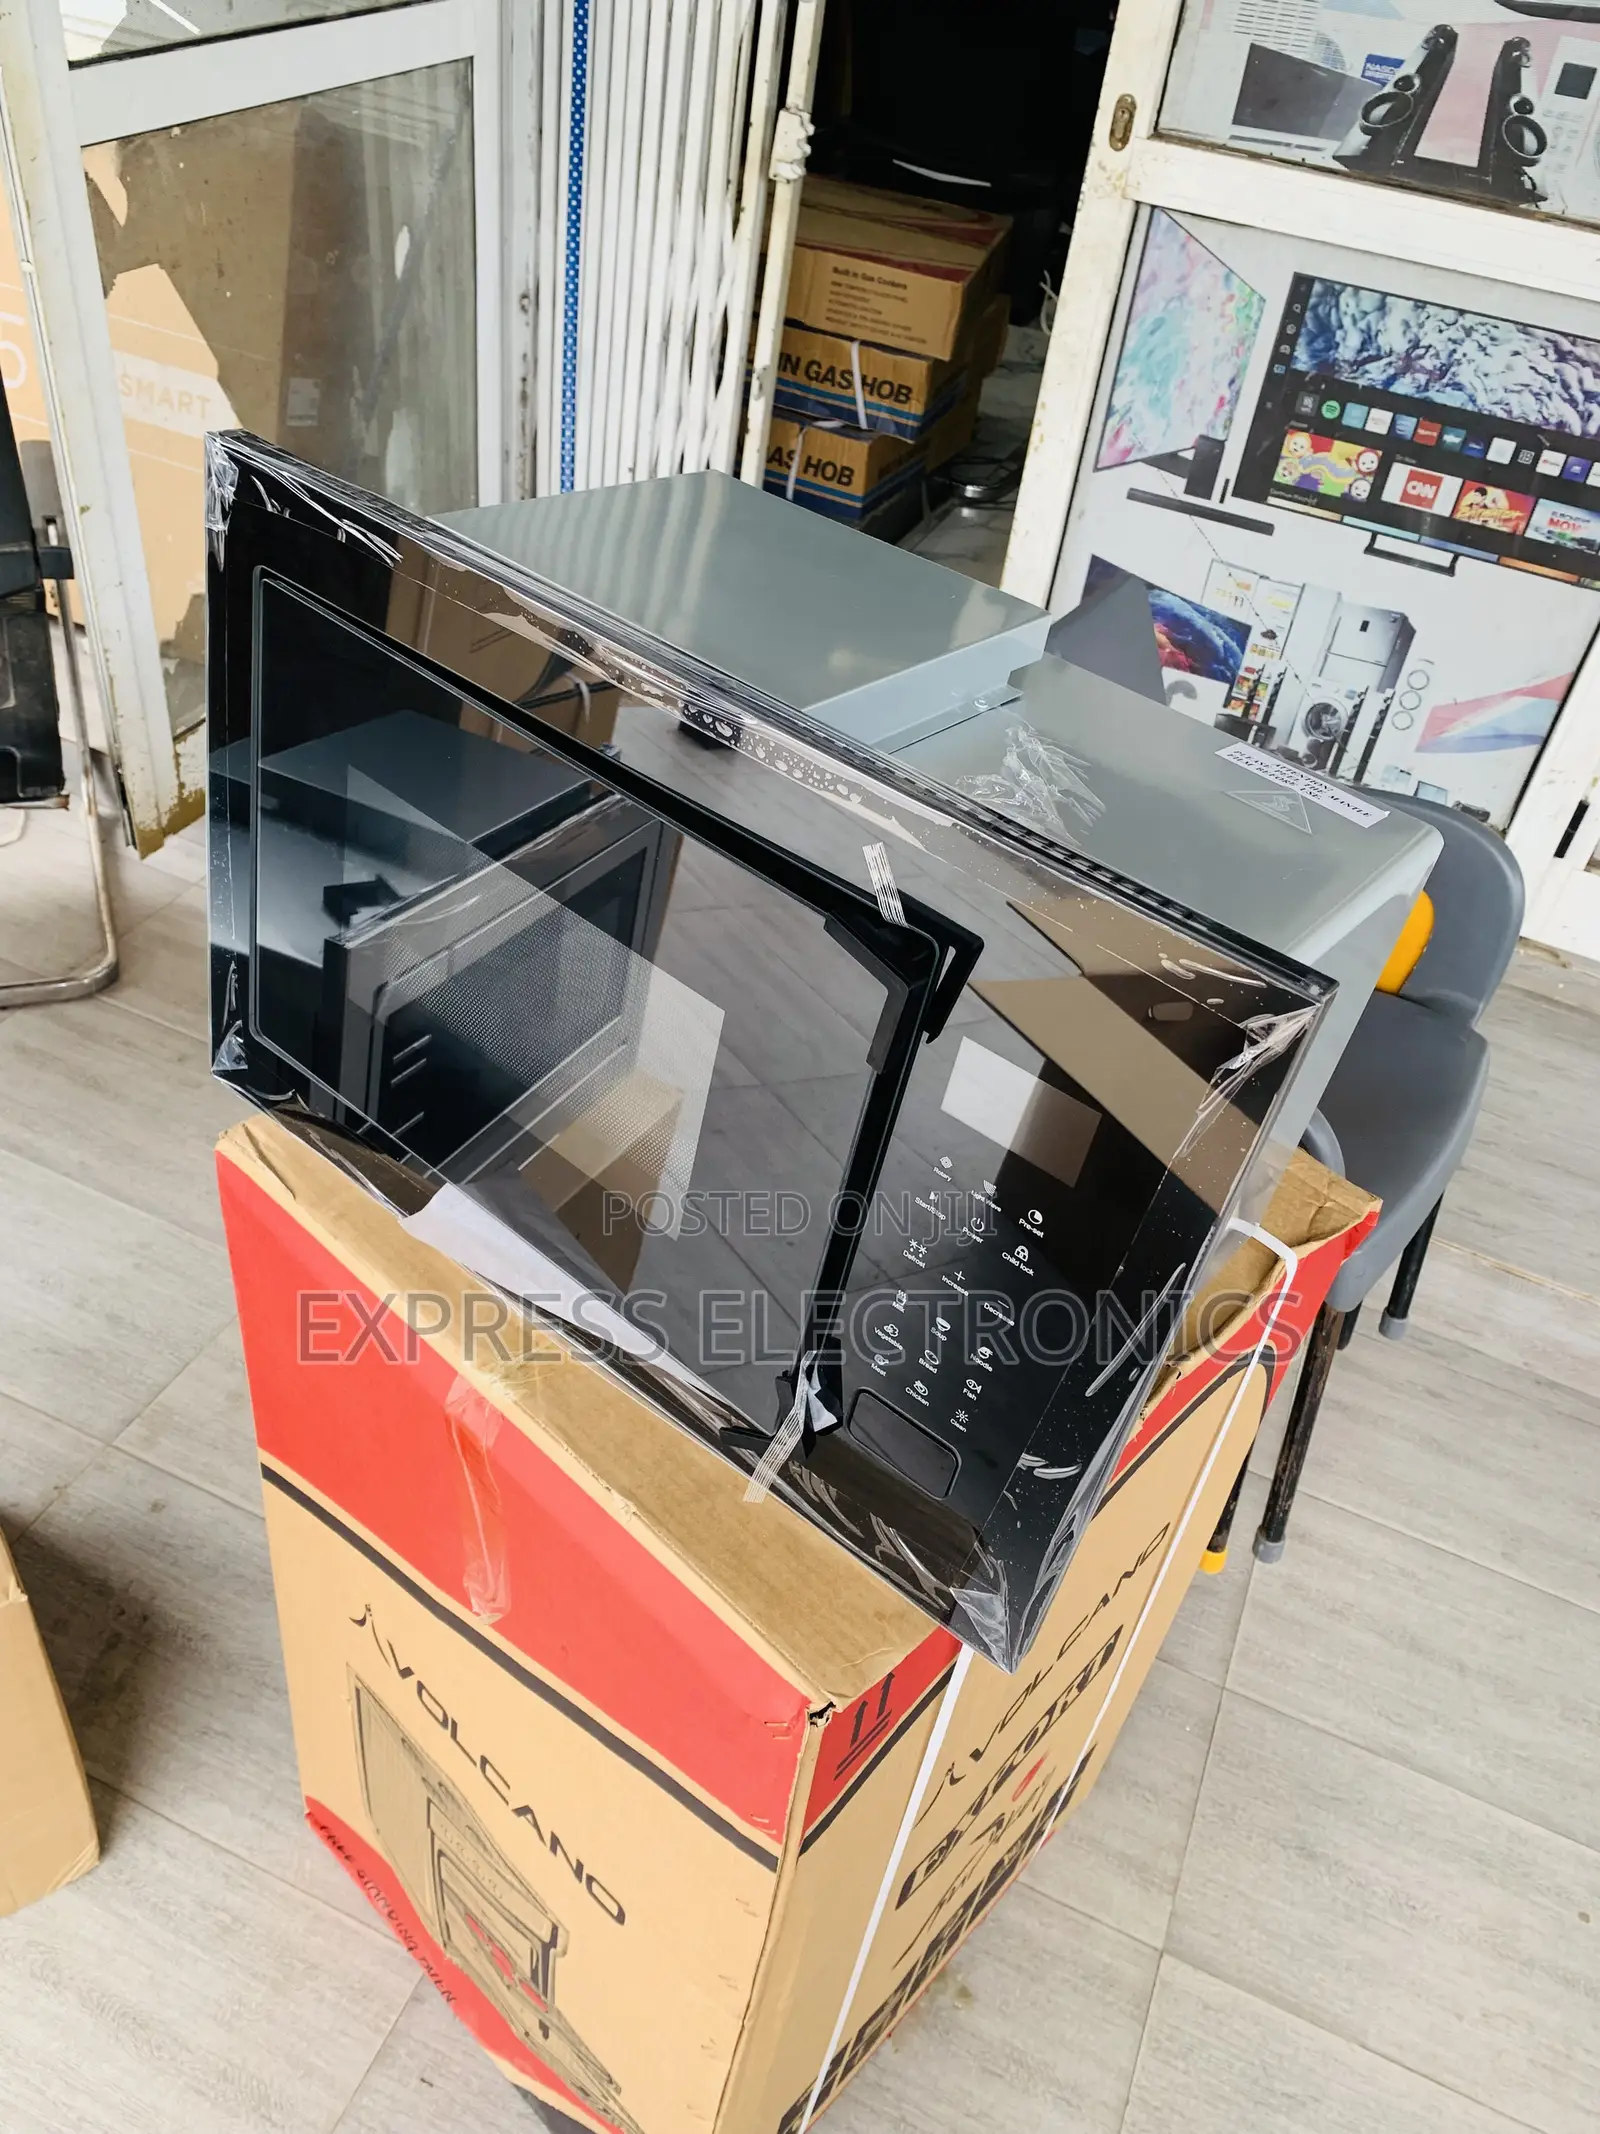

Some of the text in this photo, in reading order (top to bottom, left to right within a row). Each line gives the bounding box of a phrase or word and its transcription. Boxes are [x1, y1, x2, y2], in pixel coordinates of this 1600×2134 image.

[804, 359, 854, 390] GAS
[860, 374, 913, 405] HOB
[119, 368, 213, 420] SMART
[803, 454, 855, 487] HOB
[933, 1166, 952, 1182] Rotary
[914, 1196, 947, 1221] Start/Stop
[962, 1226, 984, 1244] Power
[1018, 1217, 1045, 1239] Pre-set
[902, 1249, 927, 1269] Defrost
[1001, 1251, 1036, 1277] Child lock
[941, 1275, 969, 1297] Increase
[892, 1301, 906, 1314] Milk
[983, 1302, 1016, 1327] Decrease
[874, 1326, 904, 1351] Vegetable
[930, 1326, 948, 1342] Soup
[870, 1362, 887, 1377] Meat
[918, 1357, 938, 1374] Bread
[969, 1353, 993, 1373] Noodle
[905, 1386, 930, 1407] Chicken
[962, 1388, 977, 1401] Fish
[950, 1418, 967, 1433] Clean
[969, 1523, 1169, 1762] VOLCANO
[387, 1638, 626, 1926] VOLCANO
